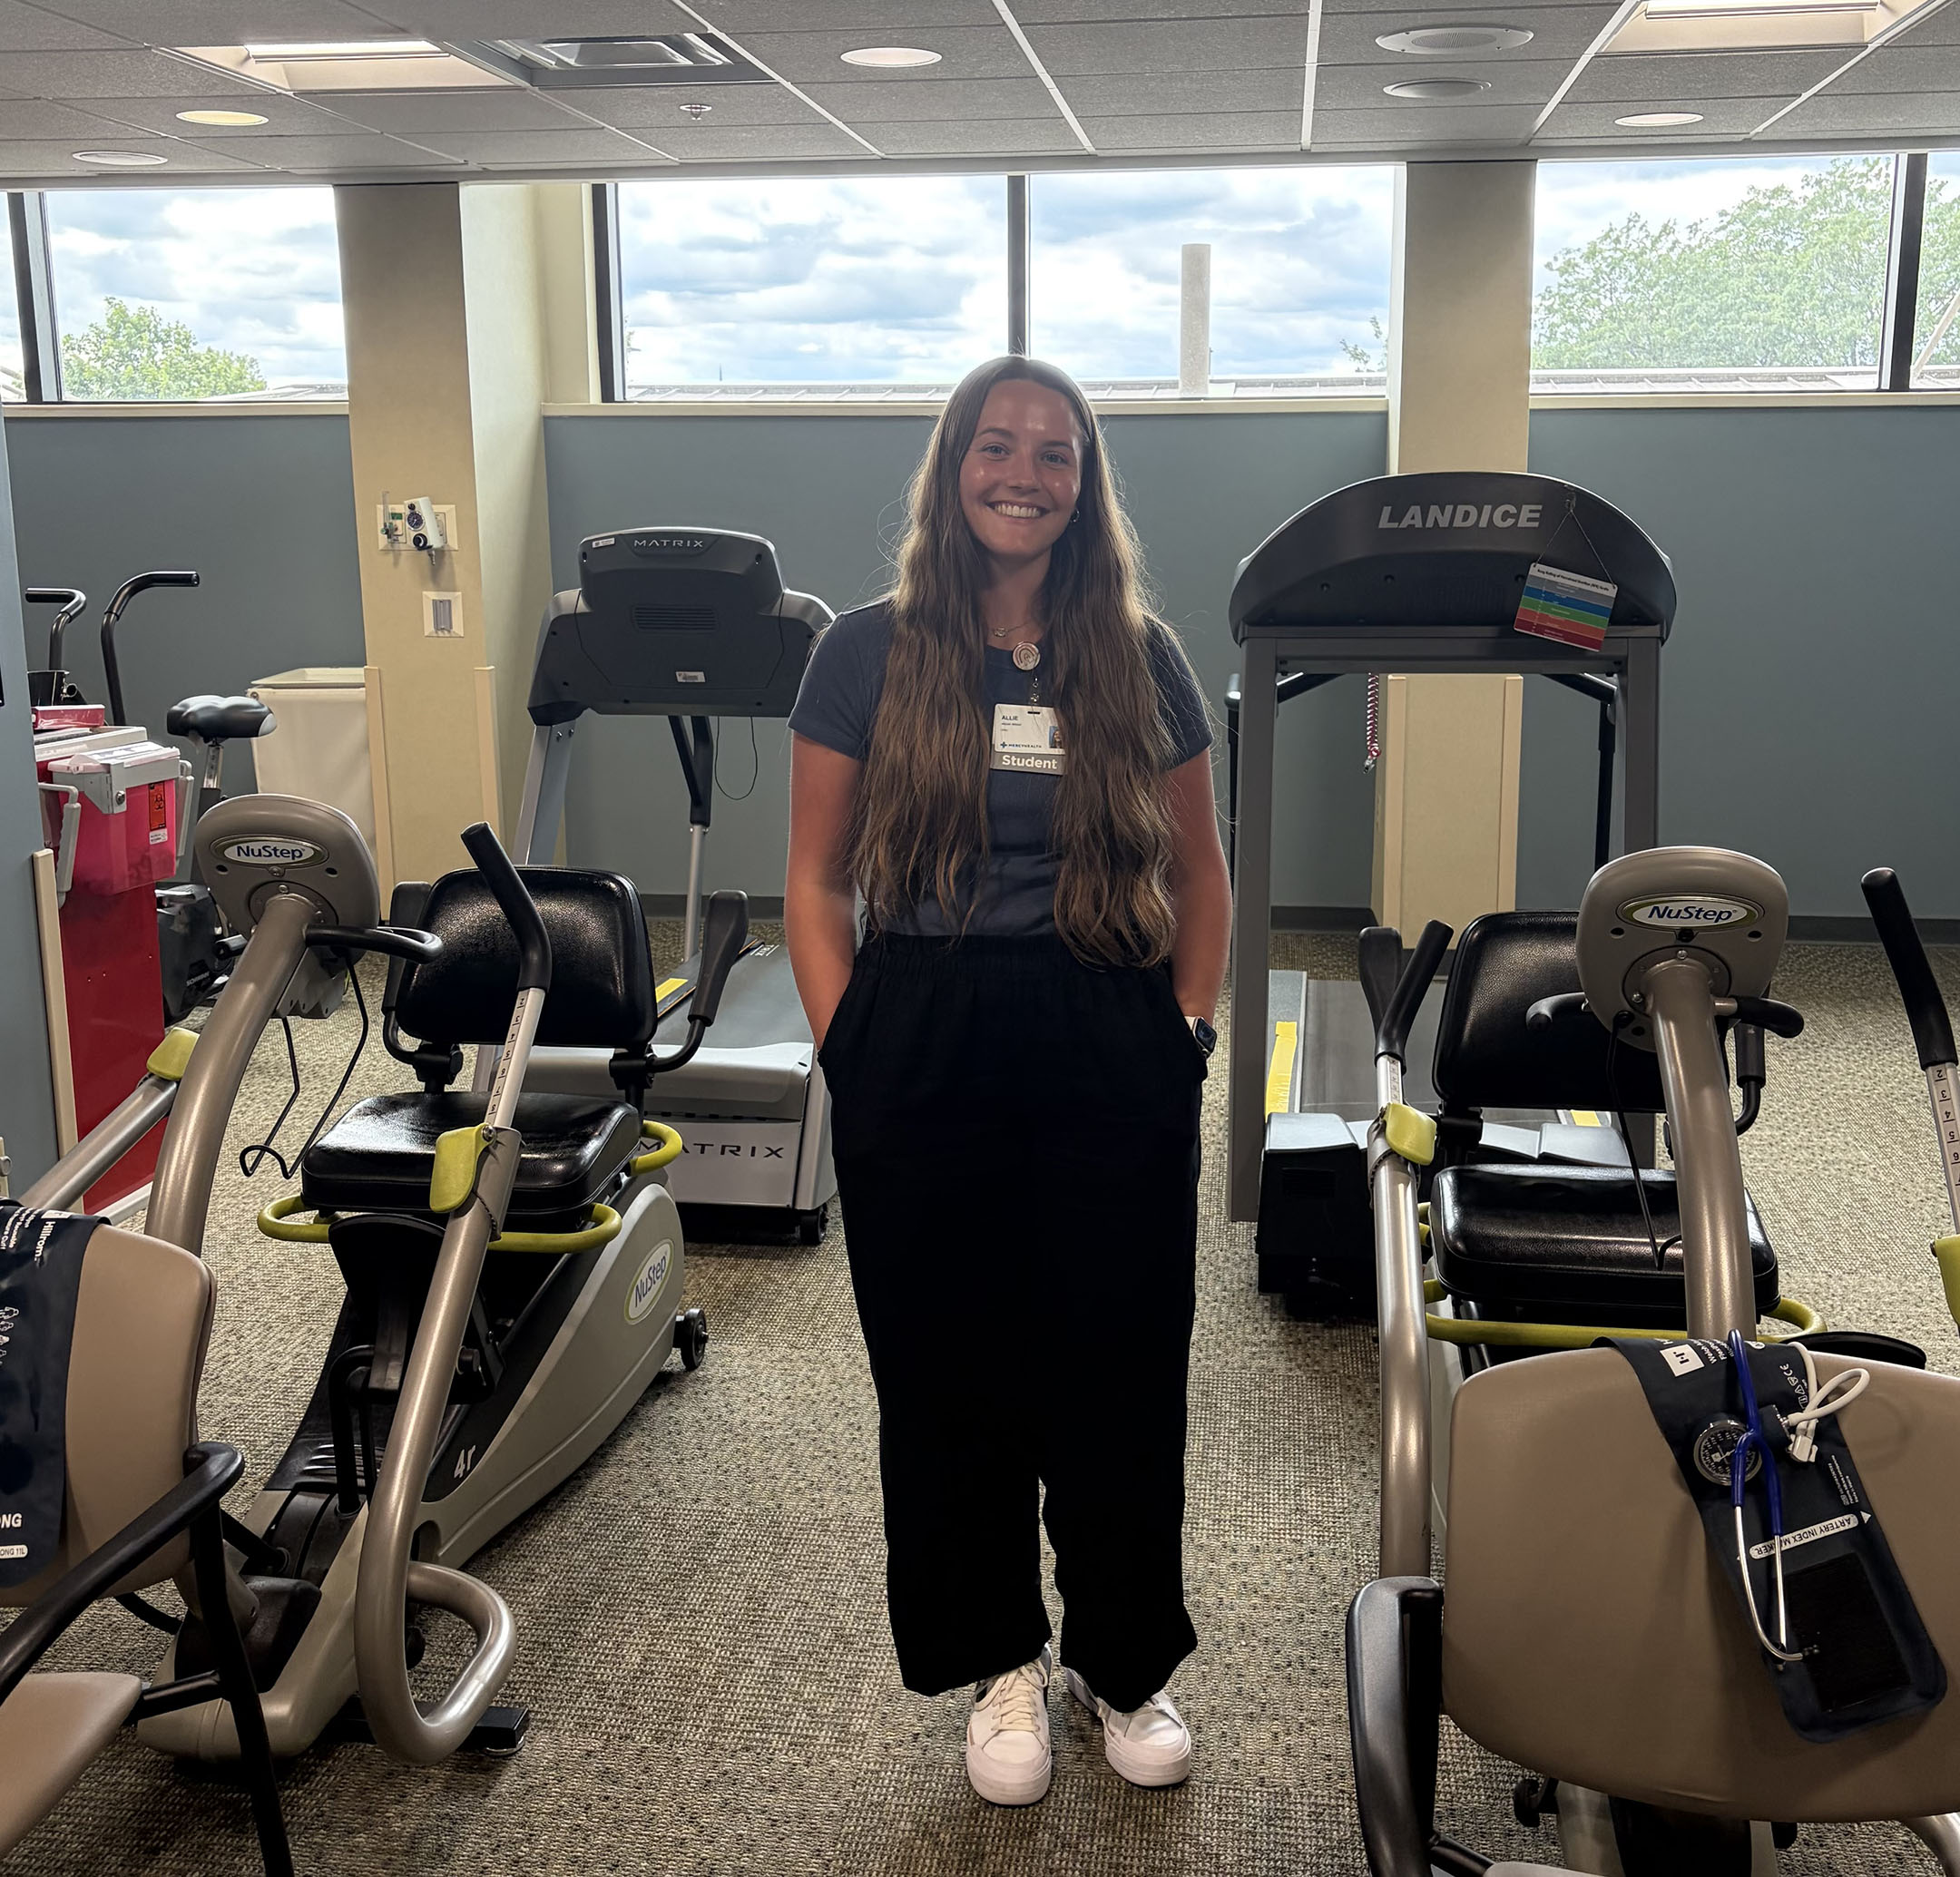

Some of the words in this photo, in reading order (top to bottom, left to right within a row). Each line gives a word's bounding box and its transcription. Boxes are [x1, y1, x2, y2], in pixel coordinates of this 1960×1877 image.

[1377, 503, 1543, 529] LANDICE
[633, 539, 703, 548] MATRIX
[1002, 754, 1058, 769] Student
[236, 845, 303, 861] NuStep
[1648, 905, 1733, 924] NuStep
[1936, 1070, 1943, 1078] 2
[1941, 1090, 1947, 1099] 3
[1945, 1110, 1951, 1119] 4
[1948, 1131, 1955, 1139] 5
[1953, 1152, 1959, 1160] 6
[34, 1220, 56, 1257] Hillrom
[635, 1255, 667, 1308] NuStep
[0, 1512, 23, 1529] NG
[1819, 1516, 1851, 1534] ARTERY
[1793, 1527, 1819, 1543] INDEX
